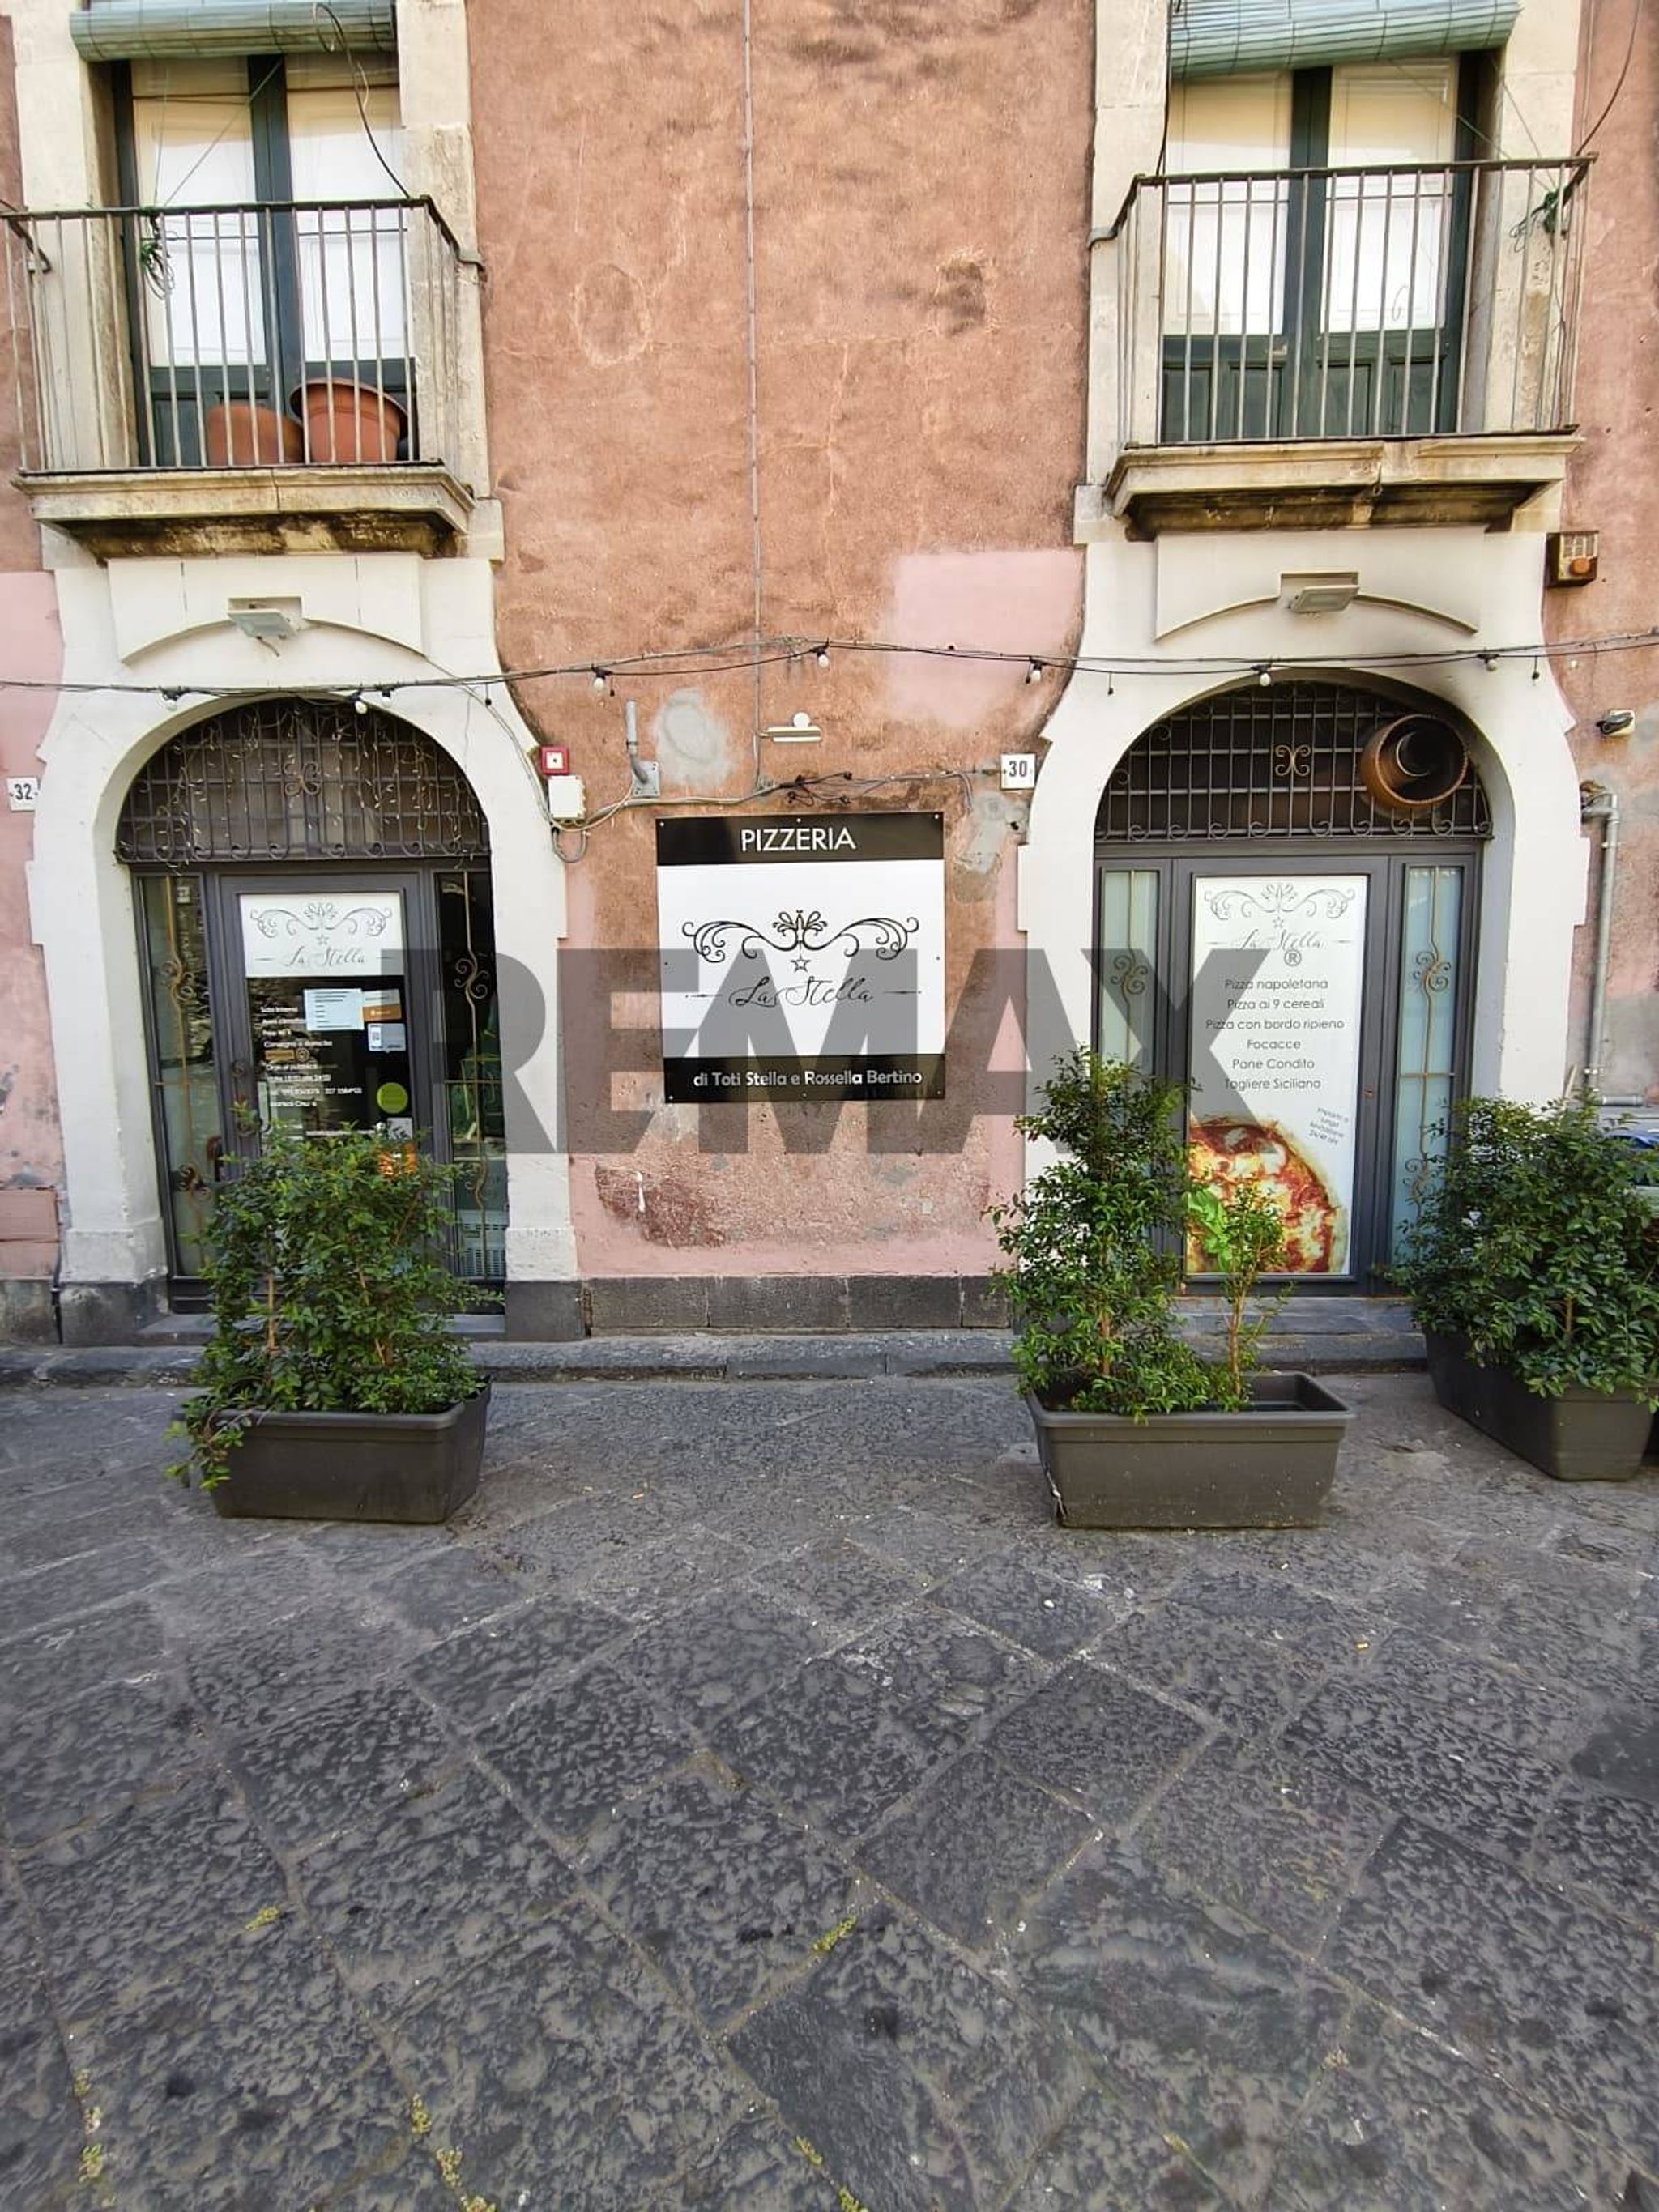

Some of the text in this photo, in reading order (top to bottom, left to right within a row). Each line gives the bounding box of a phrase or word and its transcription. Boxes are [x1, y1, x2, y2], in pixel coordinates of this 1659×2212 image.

[1009, 760, 1027, 777] 30
[14, 783, 33, 800] 32
[740, 827, 857, 852] PIZZERIA
[728, 975, 874, 1007] La Stella
[1225, 978, 1328, 991] Pizza napoletana
[1227, 999, 1324, 1010] Pizza ai 9 cereali
[1205, 1019, 1345, 1031] Pizza con bordo ripieno
[1247, 1038, 1301, 1050] Focacce
[1232, 1058, 1315, 1069] Pane Condito
[693, 1069, 922, 1087] di Toti Stella e Rossella Bertino
[1225, 1077, 1321, 1091] Tagliere Siciliano
